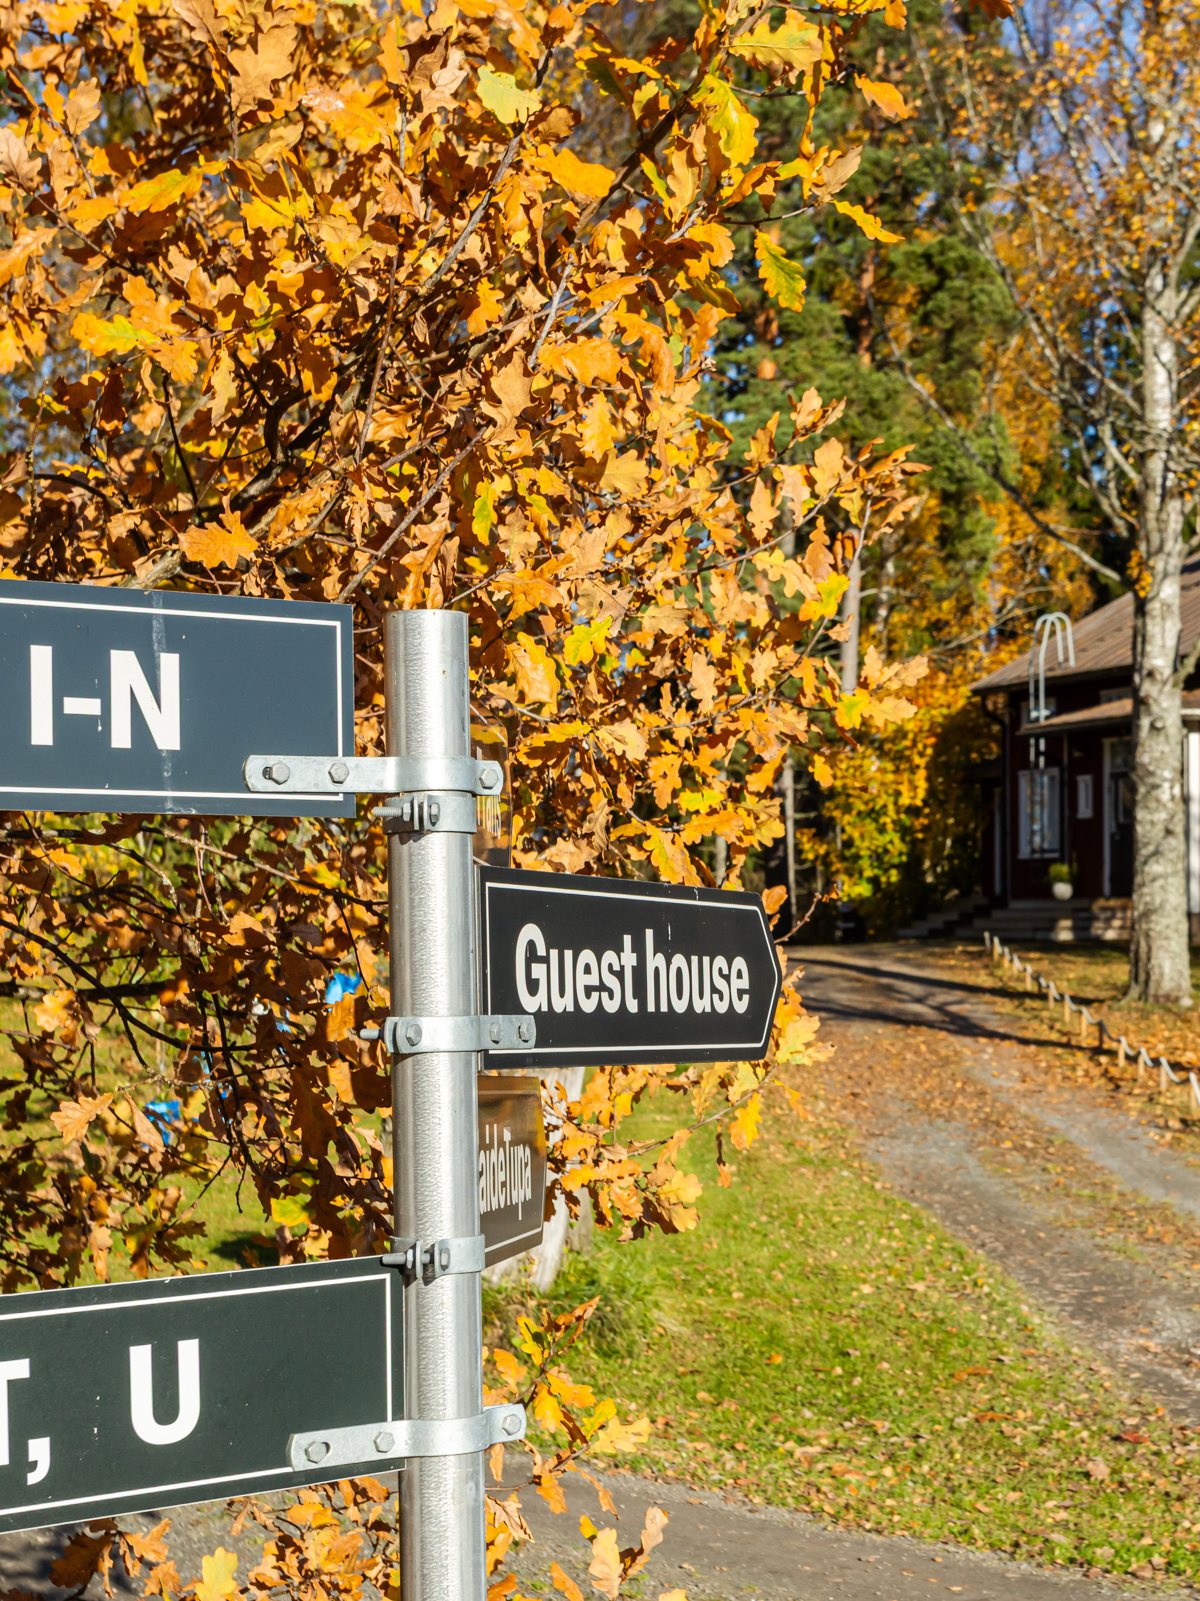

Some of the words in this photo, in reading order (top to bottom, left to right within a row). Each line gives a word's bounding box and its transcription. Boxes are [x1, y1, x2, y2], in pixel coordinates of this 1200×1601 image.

[515, 923, 638, 1013] Guest
[645, 928, 750, 1014] house
[478, 1123, 532, 1221] aideTupa
[129, 1338, 200, 1445] U
